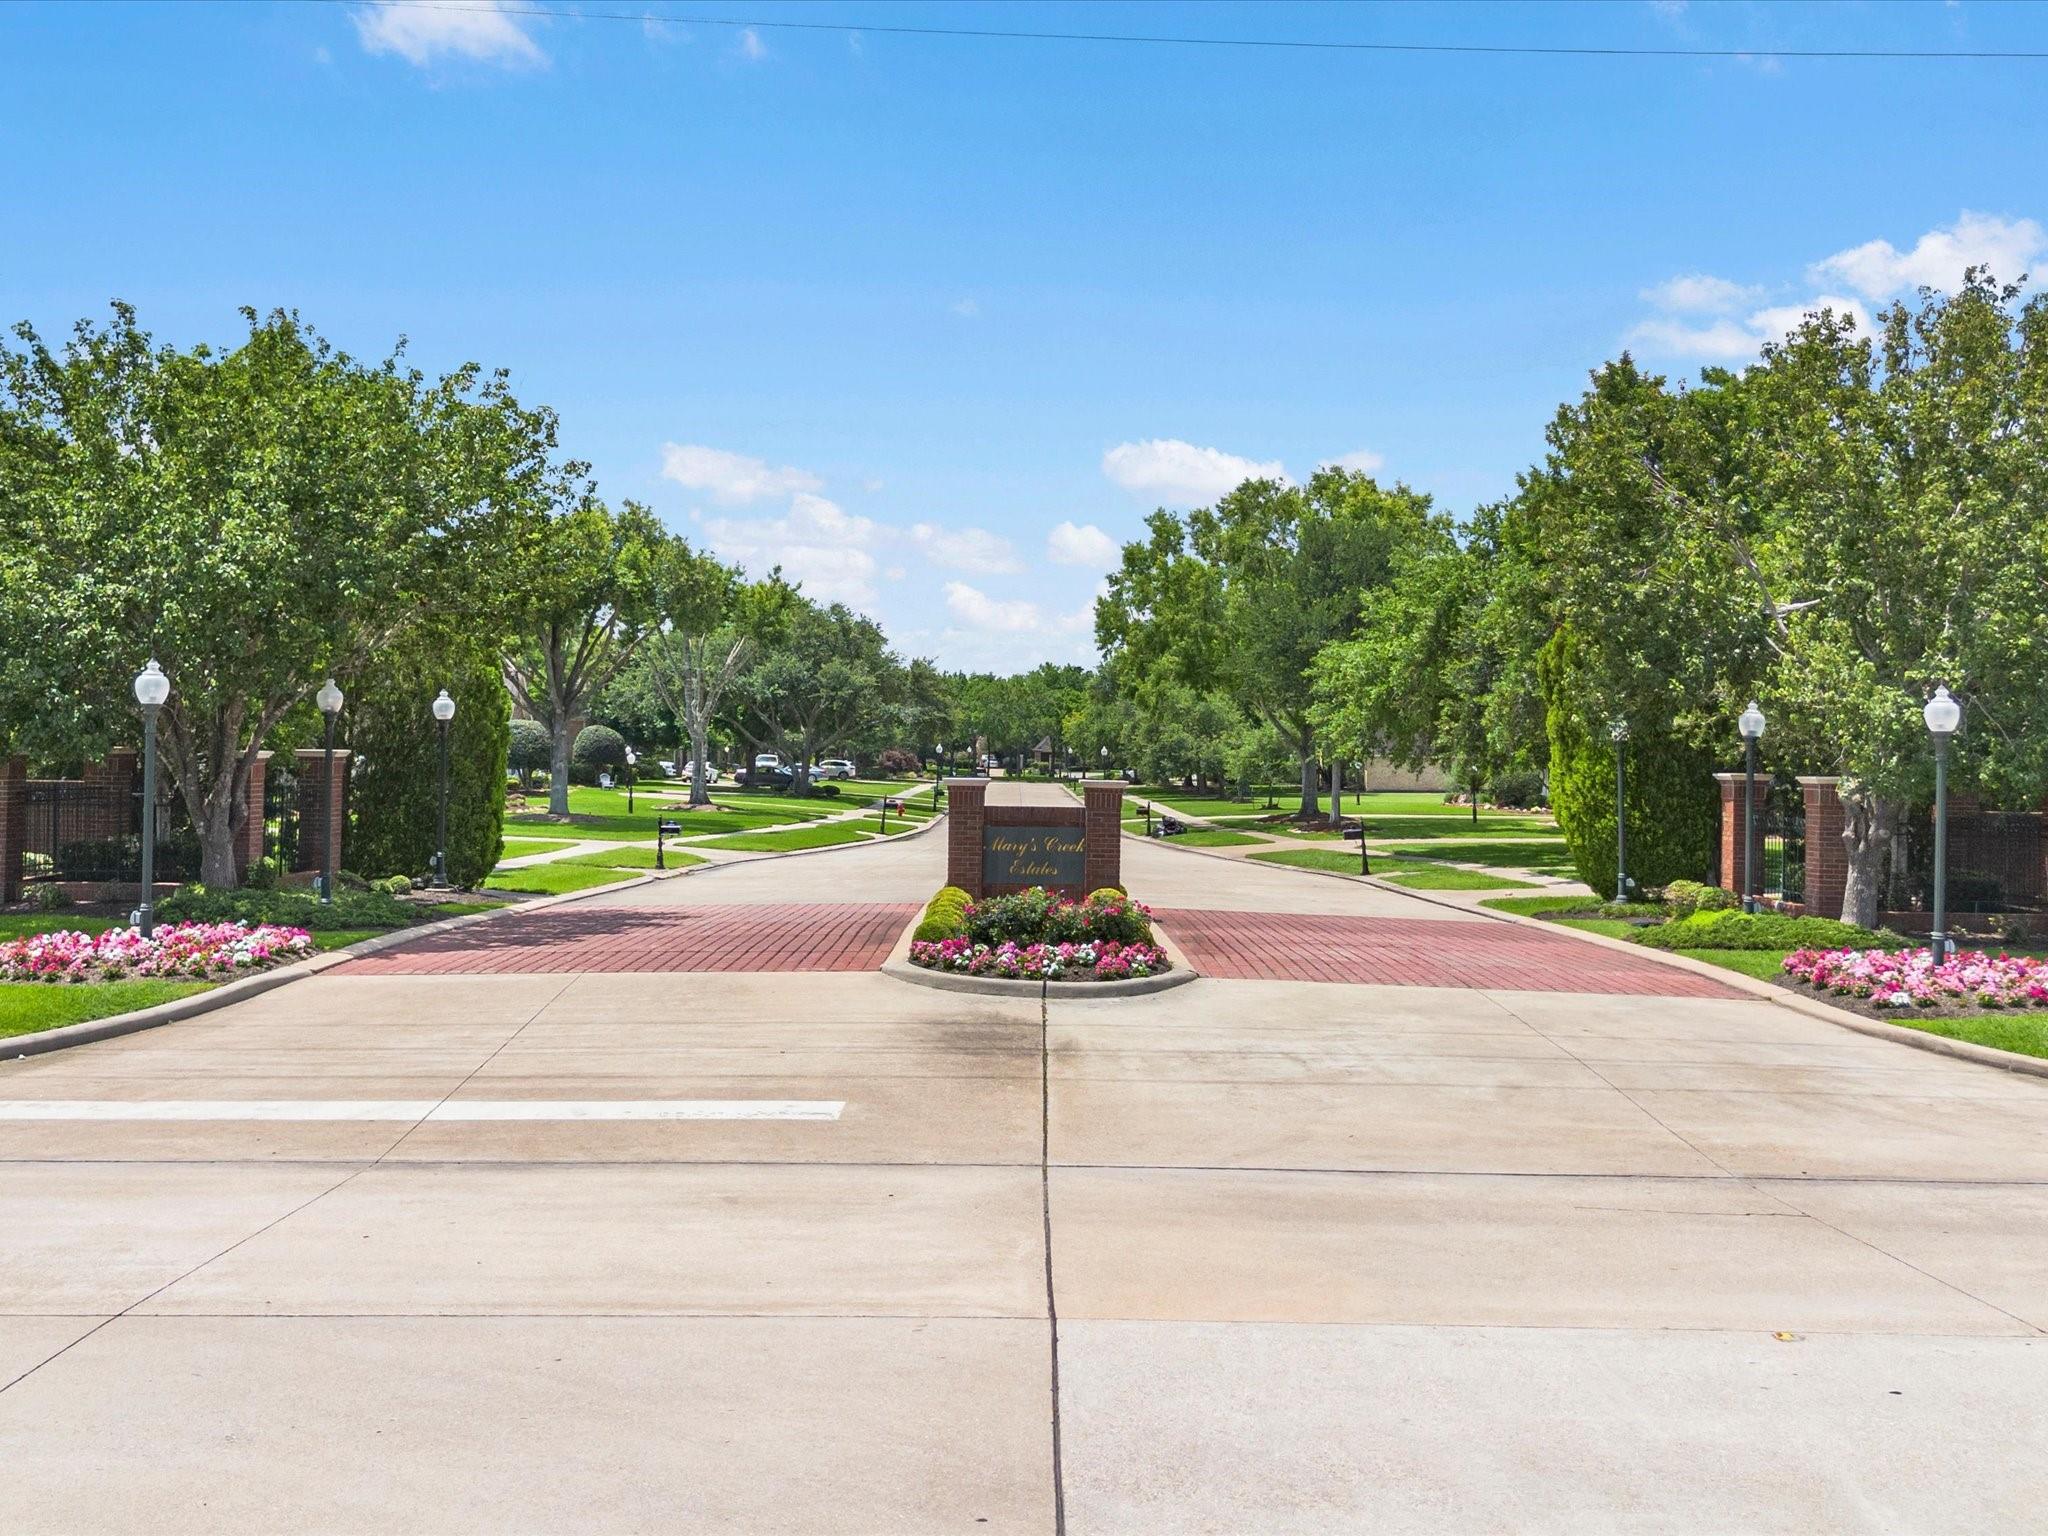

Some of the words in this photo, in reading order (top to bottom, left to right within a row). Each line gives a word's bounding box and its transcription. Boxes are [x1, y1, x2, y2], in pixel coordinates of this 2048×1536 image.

[991, 836, 1037, 857] Mary's
[1044, 836, 1085, 852] Creek
[1009, 859, 1059, 875] Estates
